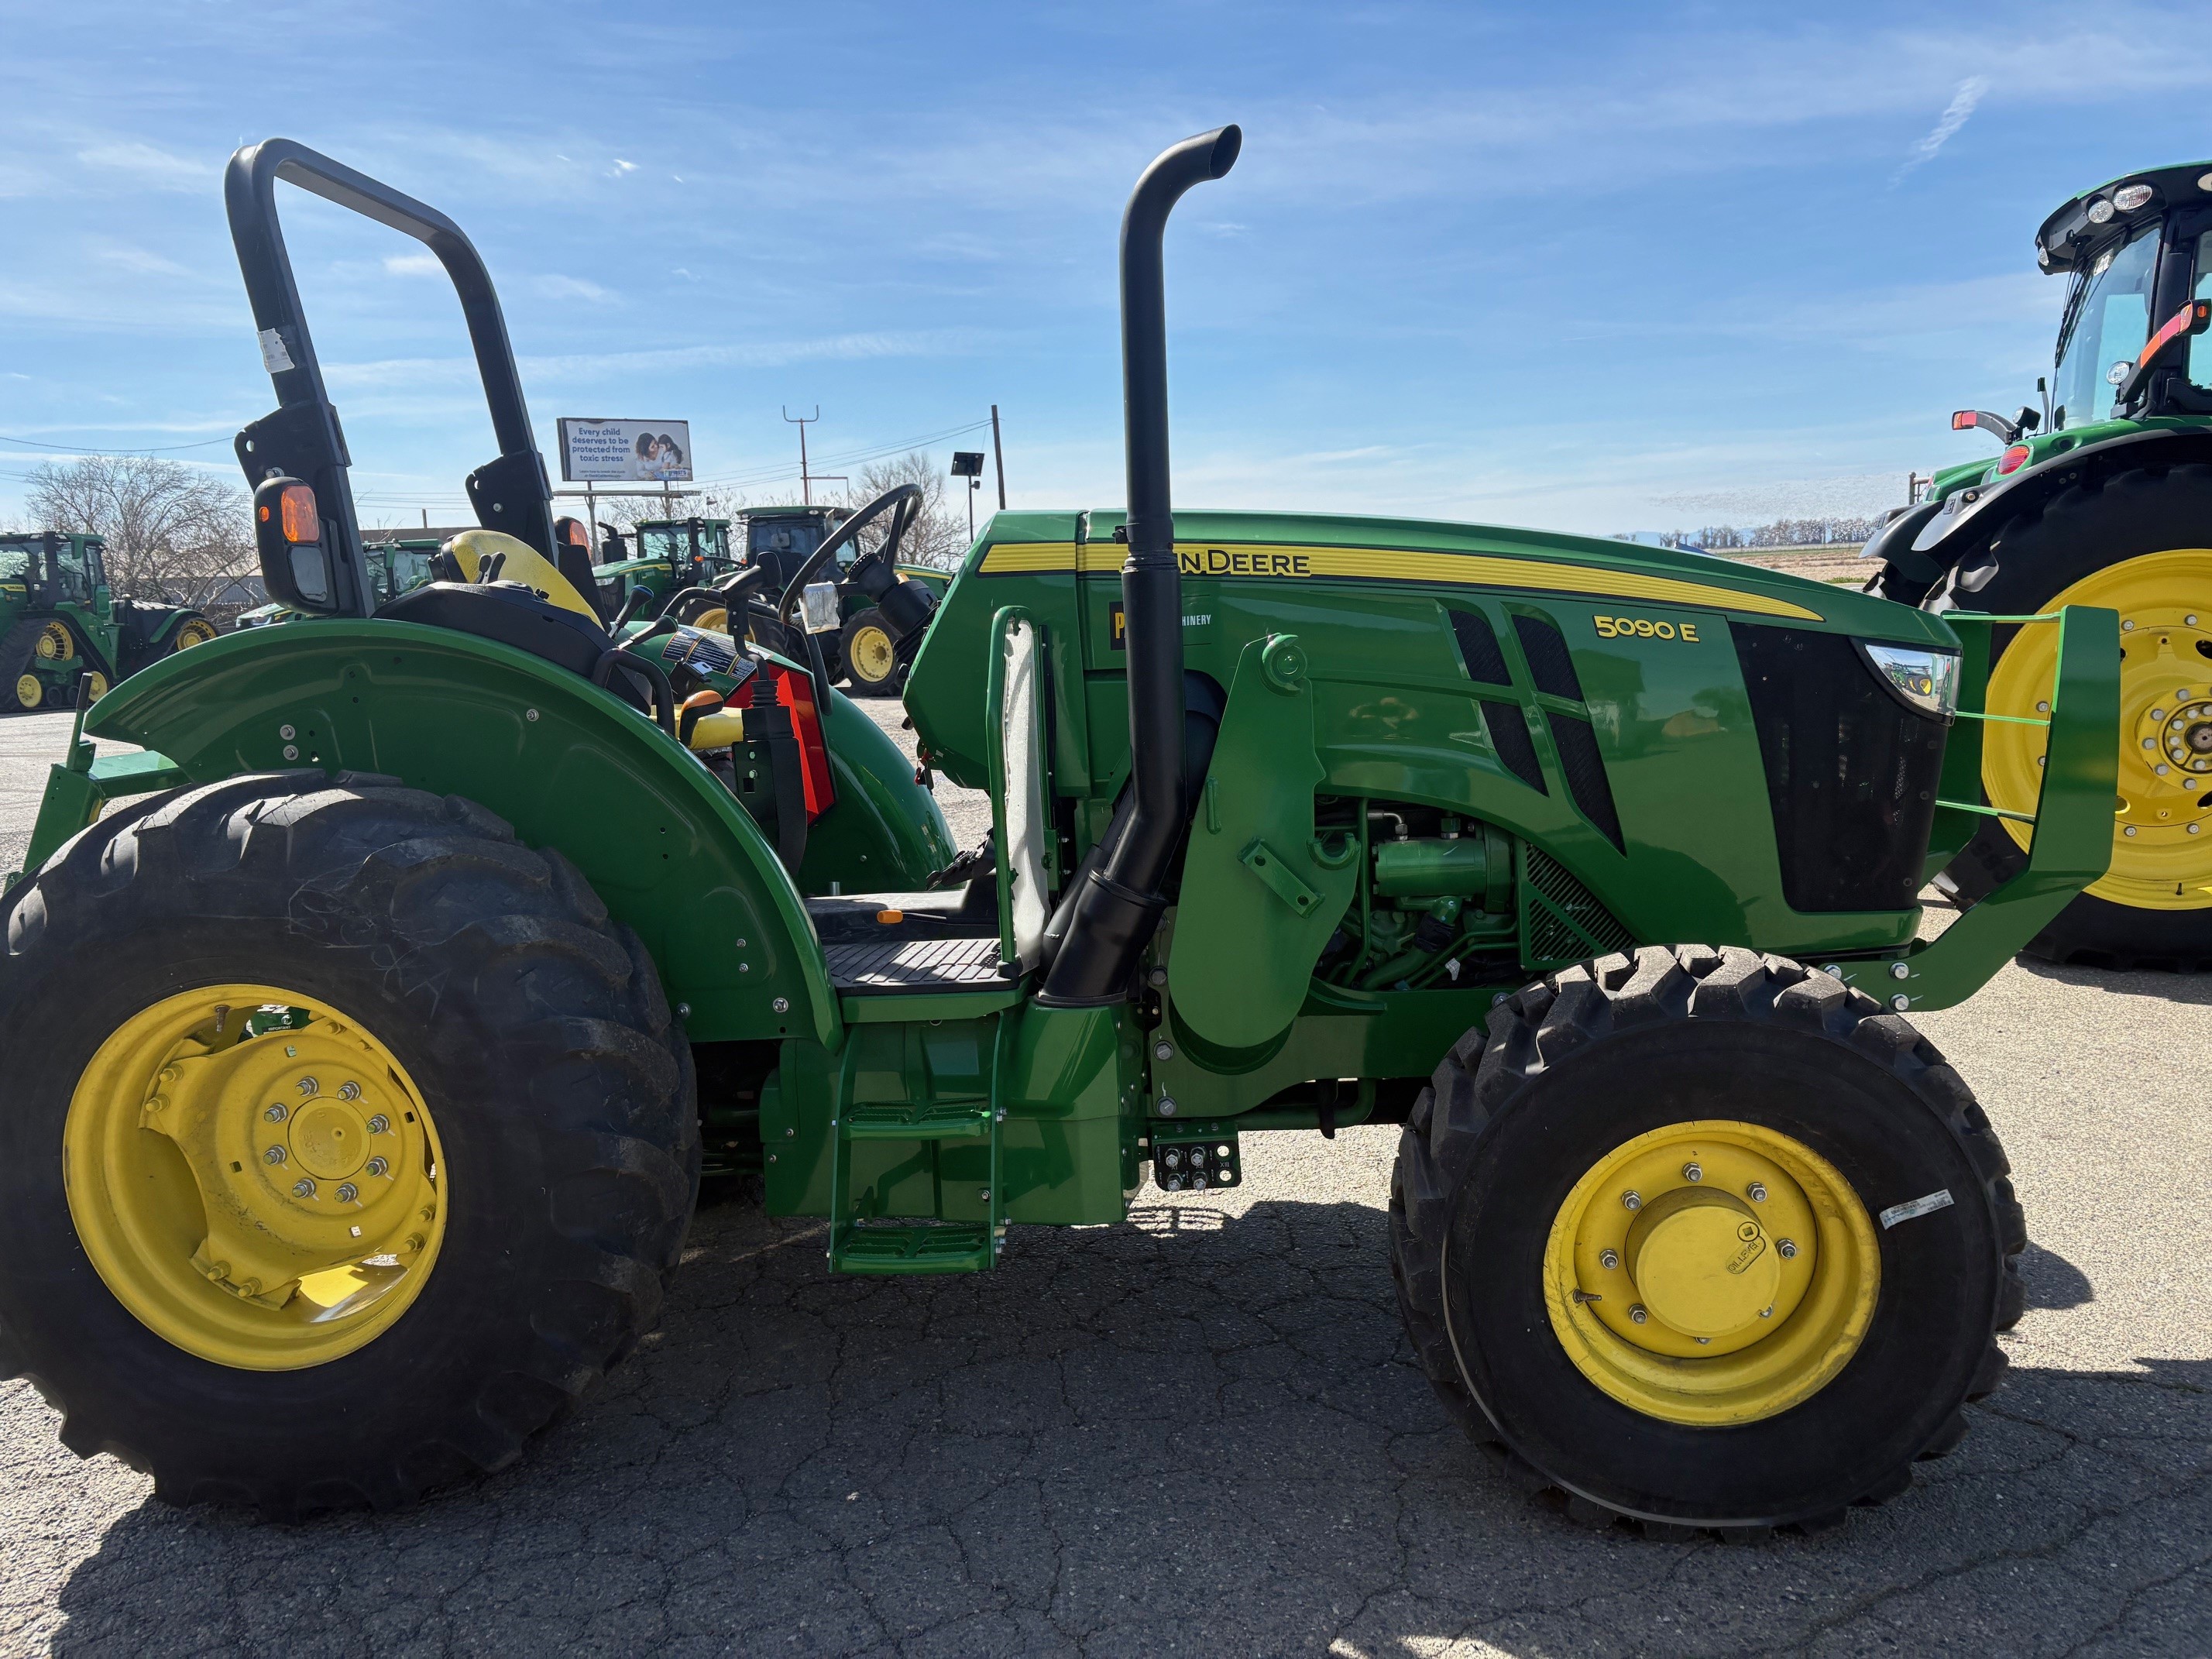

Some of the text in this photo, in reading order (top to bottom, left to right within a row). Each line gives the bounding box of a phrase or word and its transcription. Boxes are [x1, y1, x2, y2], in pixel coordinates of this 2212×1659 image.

[579, 428, 600, 437] Every
[1207, 549, 1310, 574] DEERE
[1182, 614, 1211, 627] HINERY
